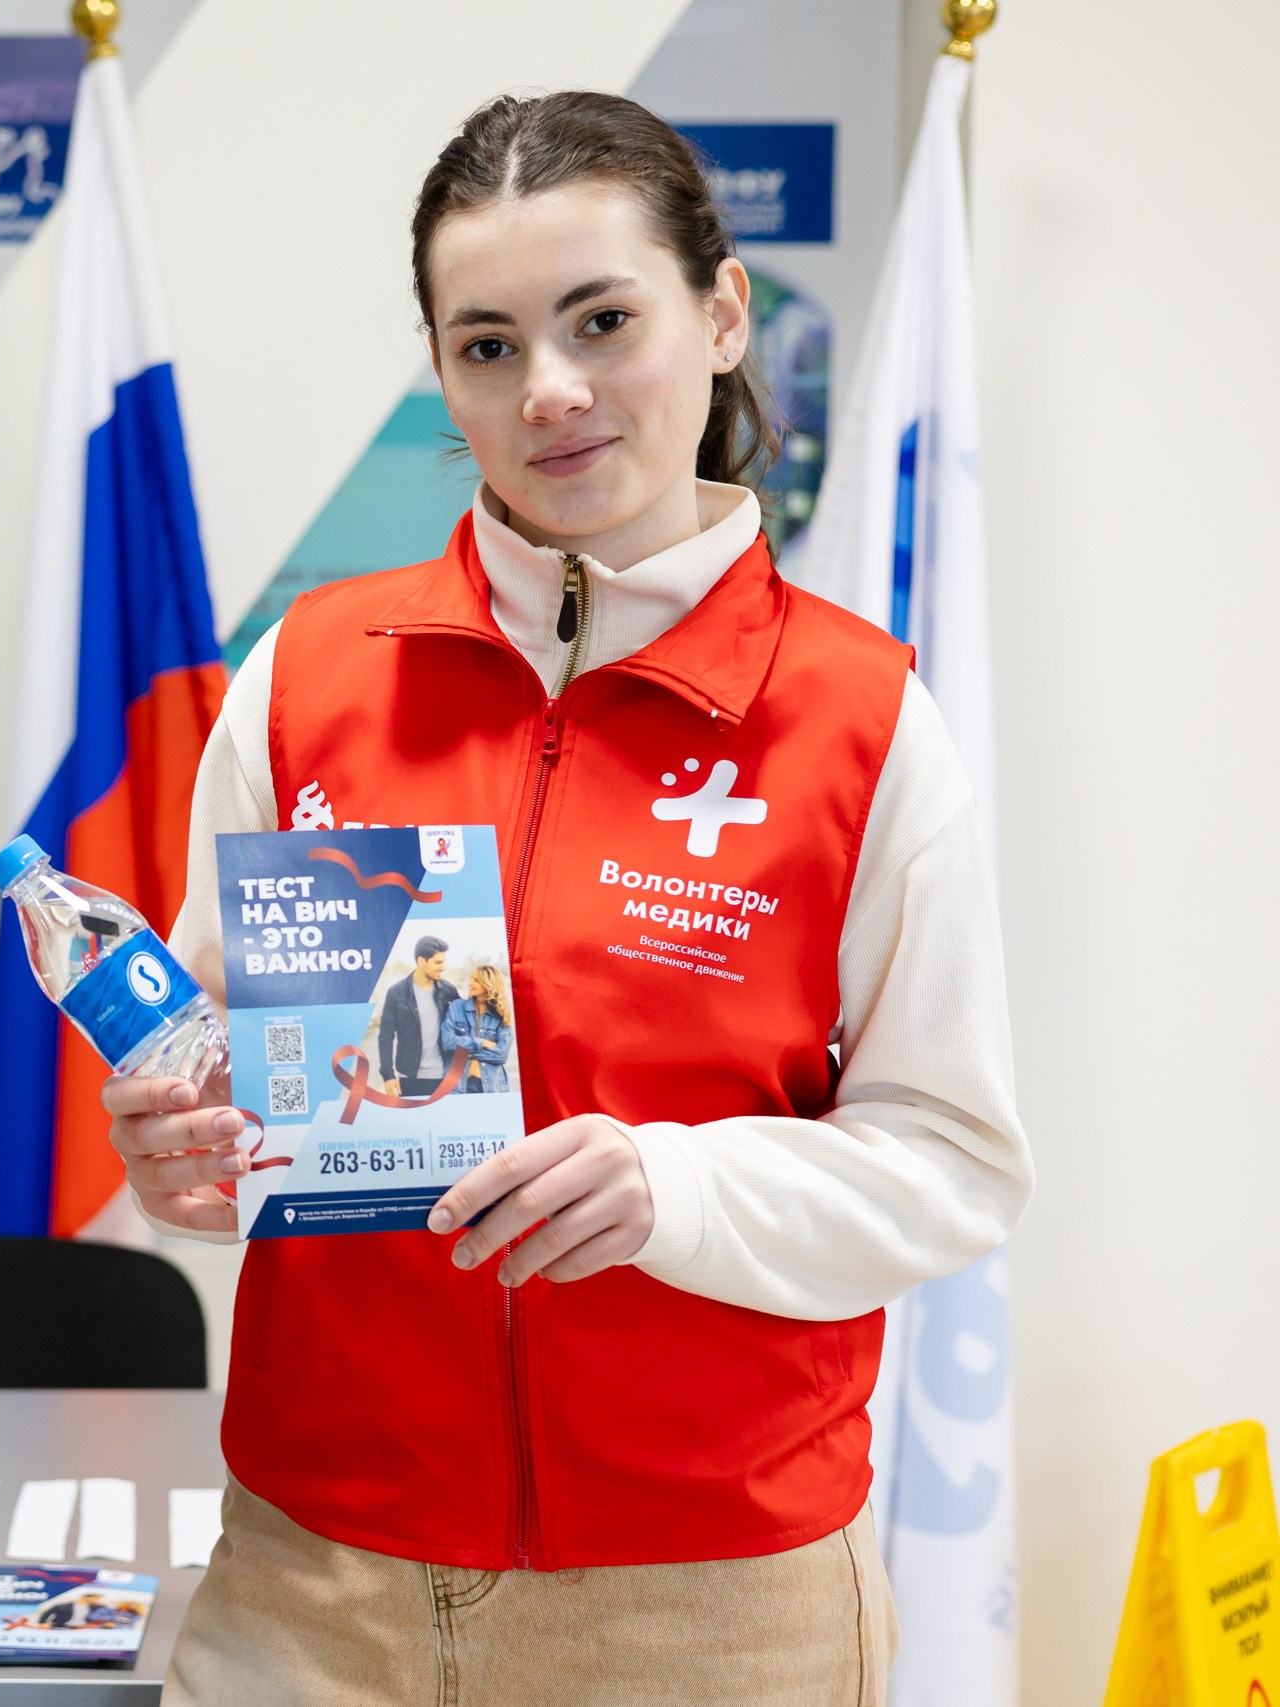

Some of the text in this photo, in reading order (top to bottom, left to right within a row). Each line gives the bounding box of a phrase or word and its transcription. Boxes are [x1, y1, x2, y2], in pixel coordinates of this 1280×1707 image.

[238, 876, 315, 900] ТЕСТ
[599, 859, 780, 917] Волонтеры
[241, 899, 358, 925] НА ВИЧ
[623, 899, 751, 941] медики
[262, 925, 323, 950] ЭТО
[639, 934, 727, 963] Всероссийское
[245, 949, 373, 975] ВАЖНО!
[606, 944, 745, 983] общественное движение
[318, 1141, 356, 1151] ТЕЛЕФОН
[319, 1147, 425, 1175] 263-63-11
